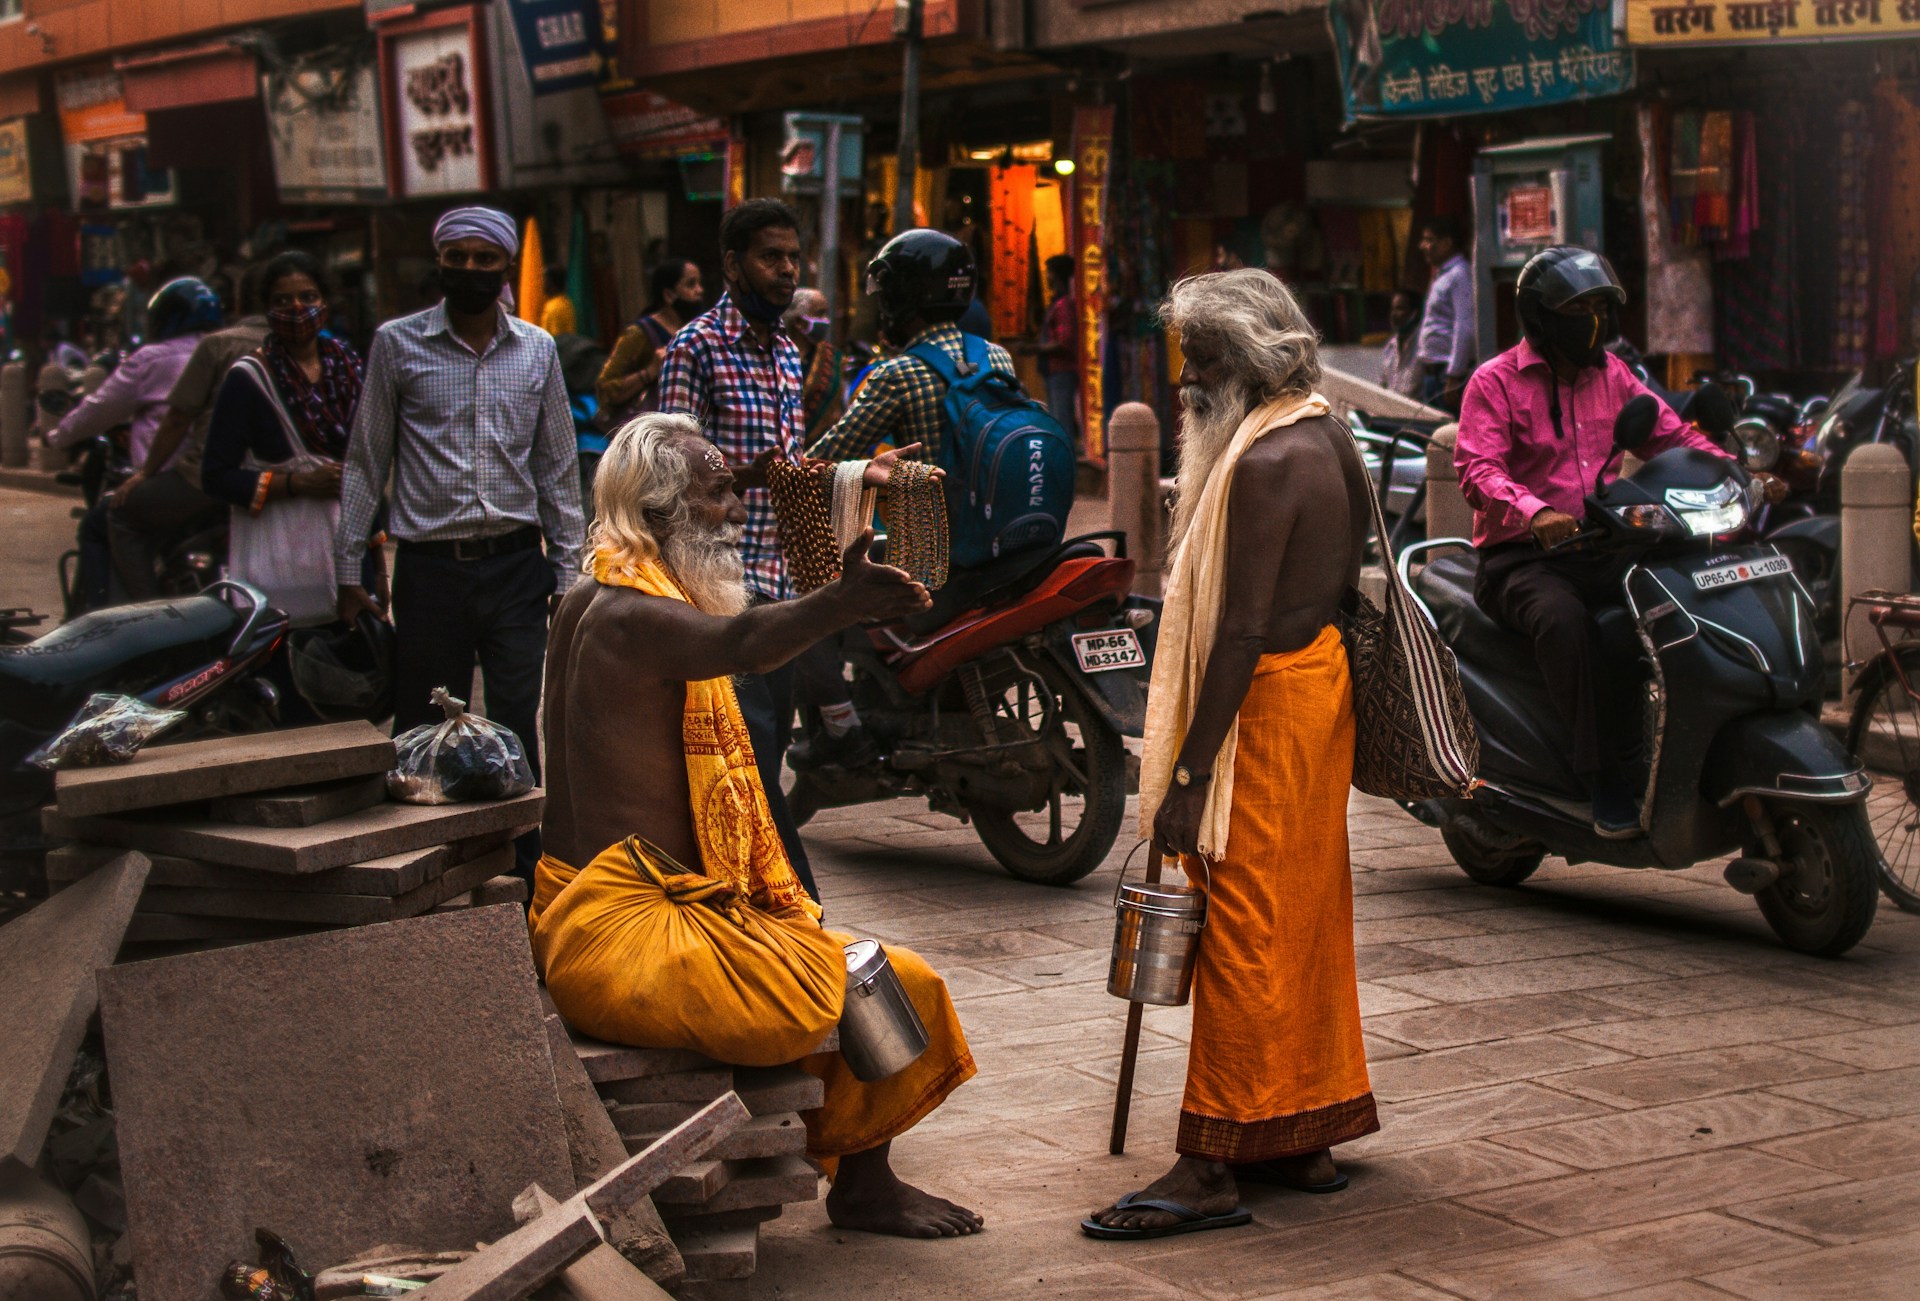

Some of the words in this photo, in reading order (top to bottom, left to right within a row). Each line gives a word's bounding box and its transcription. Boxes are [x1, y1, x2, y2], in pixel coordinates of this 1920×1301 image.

[1811, 0, 1883, 26] तरग
[1472, 67, 1500, 103] सूट
[1502, 54, 1525, 91] एवं
[1029, 439, 1045, 506] RANGER
